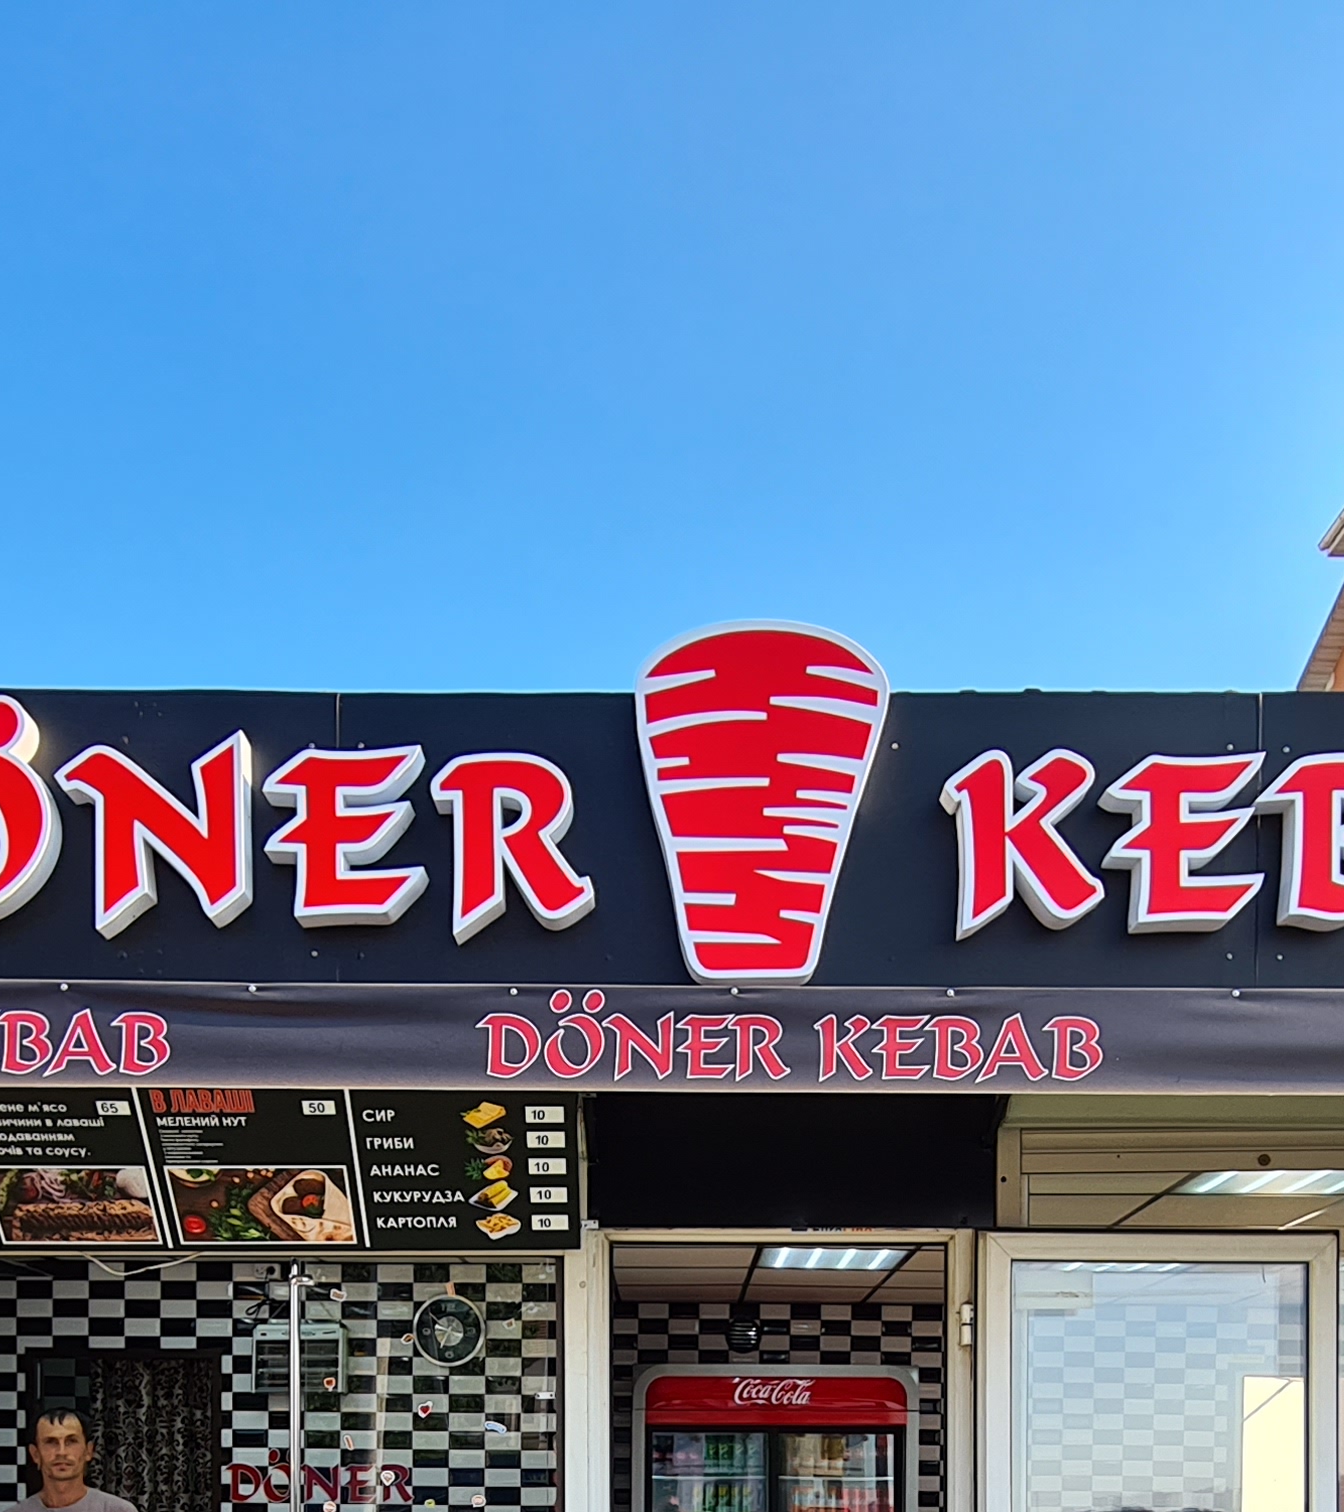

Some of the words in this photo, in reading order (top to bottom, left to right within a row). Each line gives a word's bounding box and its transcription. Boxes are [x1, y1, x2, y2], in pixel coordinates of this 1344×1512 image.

[476, 988, 791, 1082] DÖNER
[813, 1012, 1104, 1084] KEBAB
[27, 1101, 67, 1113] м'ясо
[101, 1102, 119, 1114] 65
[149, 1089, 168, 1113] В
[169, 1089, 256, 1113] ЛАВАШІ
[308, 1102, 325, 1113] 50
[56, 1116, 105, 1127] лаваші
[156, 1115, 220, 1127] МЕЛЕНИЙ
[222, 1116, 247, 1127] НУТ
[362, 1109, 396, 1122] СИР
[531, 1110, 545, 1120] 10
[365, 1137, 414, 1150] ГРИБИ
[535, 1135, 549, 1146] 10
[25, 1146, 43, 1155] та
[45, 1146, 91, 1158] соусу.
[370, 1163, 440, 1177] АНАНАС
[535, 1162, 549, 1172] 10
[373, 1190, 465, 1204] КУКУРУДЗА
[537, 1189, 552, 1200] 10
[376, 1216, 458, 1229] КАРТОПЛЯ
[537, 1218, 551, 1228] 10
[732, 1377, 816, 1405] Coca-Cola
[226, 1449, 414, 1503] DÖNER
